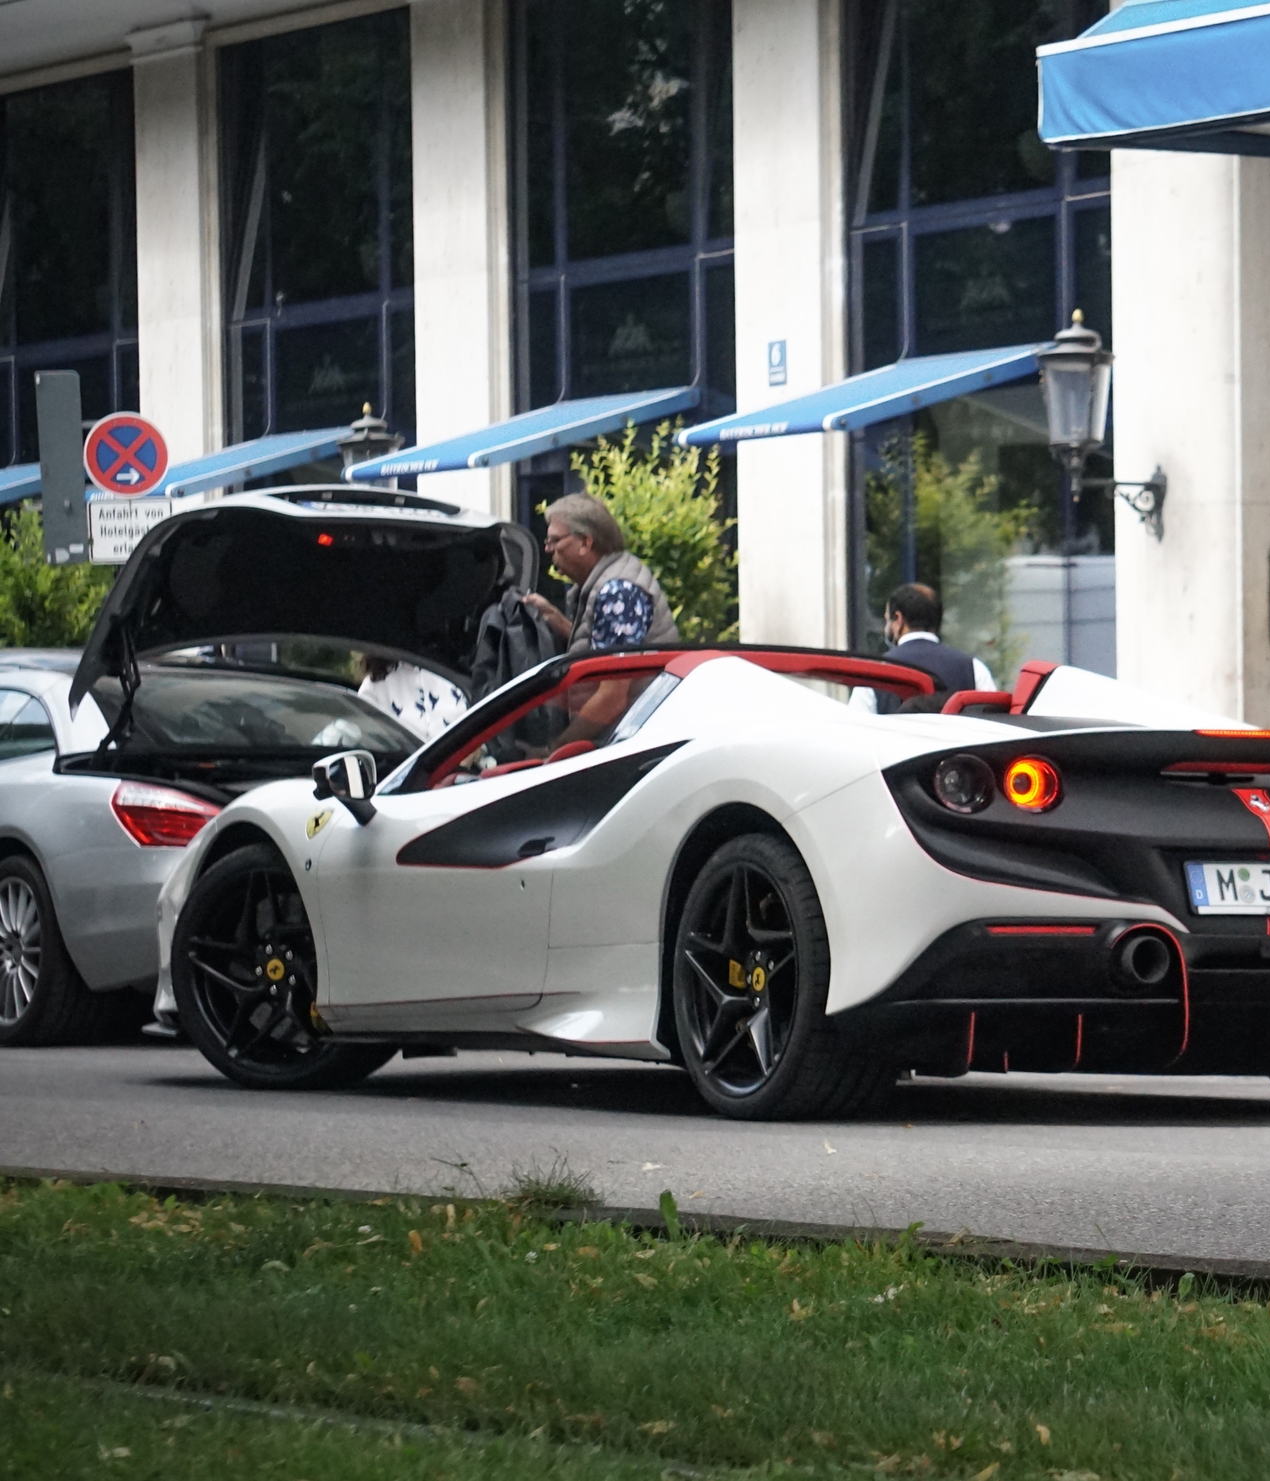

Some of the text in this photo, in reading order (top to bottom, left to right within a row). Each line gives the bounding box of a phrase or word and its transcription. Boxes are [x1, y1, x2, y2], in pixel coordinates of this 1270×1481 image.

[99, 507, 164, 521] Anfahrt von
[114, 541, 137, 555] erla
[1216, 869, 1238, 901] M
